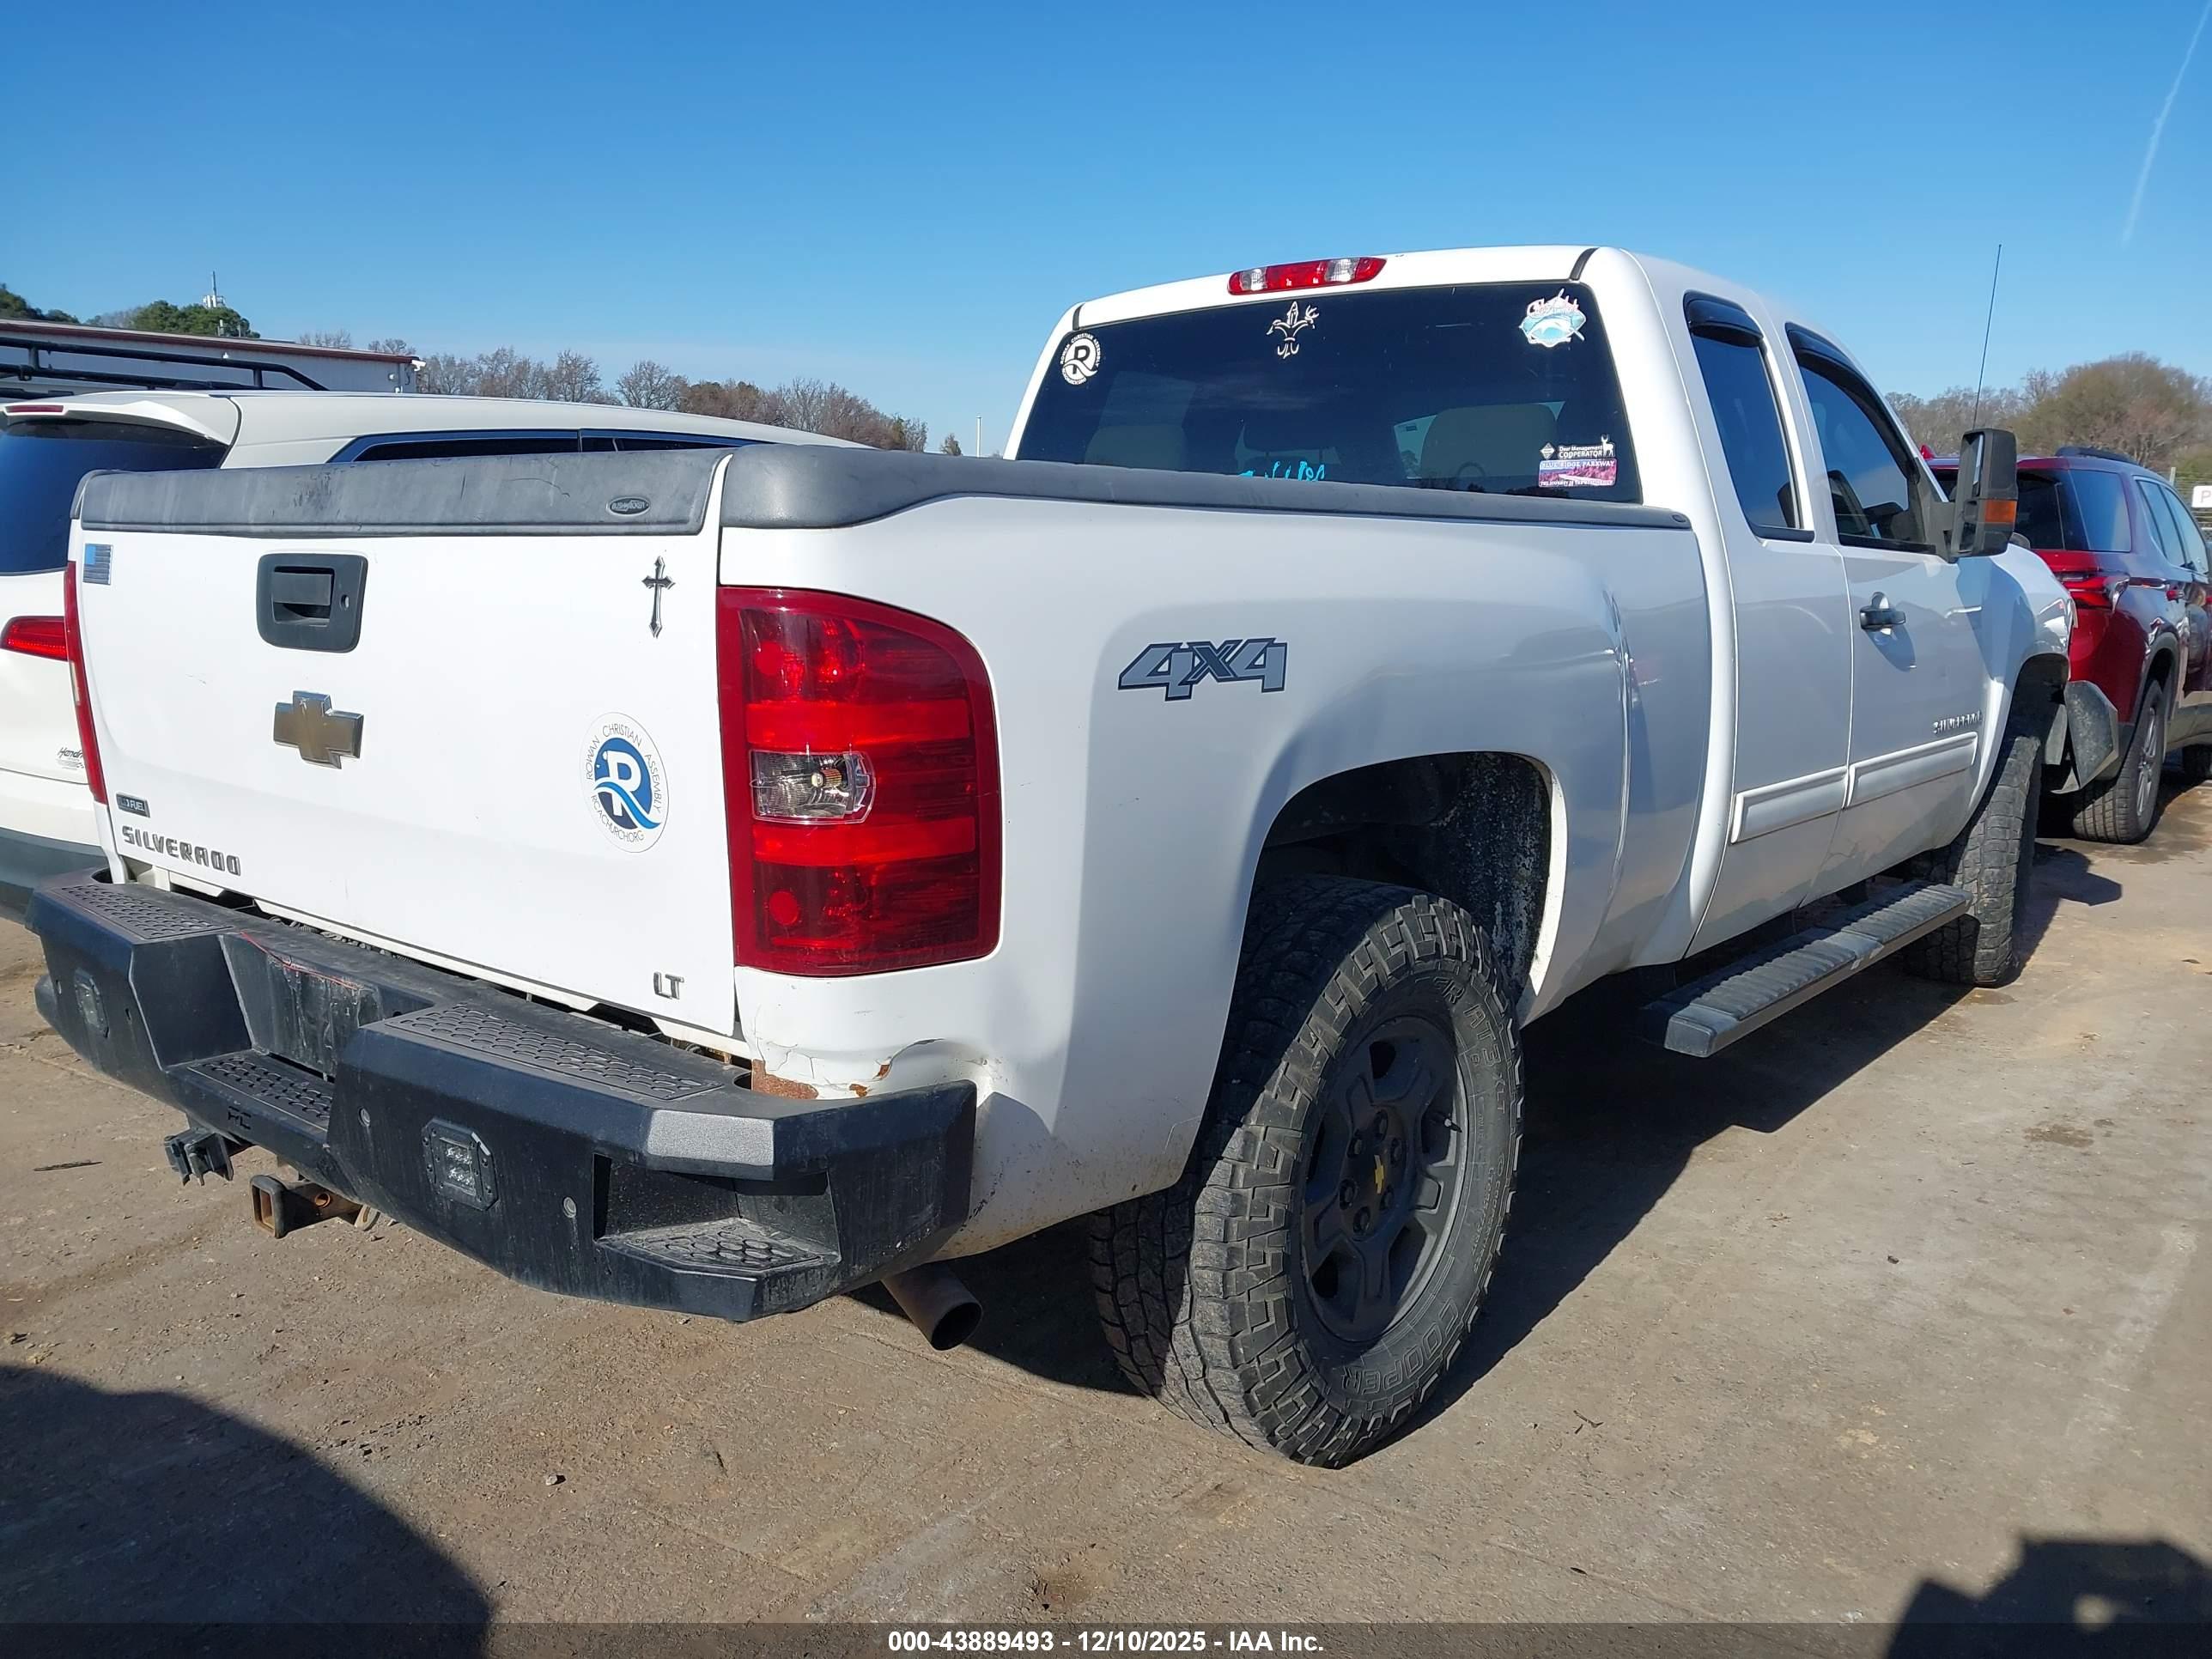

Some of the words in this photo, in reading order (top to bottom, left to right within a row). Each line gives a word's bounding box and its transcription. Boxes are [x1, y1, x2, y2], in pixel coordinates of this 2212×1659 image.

[1559, 451, 1603, 459] COOPERATOR
[586, 735, 600, 781] ROWAN
[602, 723, 642, 748] CHRISTIAN
[644, 753, 663, 814] ASSEMBLY
[122, 825, 241, 877] SILVERADO
[653, 971, 685, 1000] LT
[1341, 1297, 1460, 1396] COOPER
